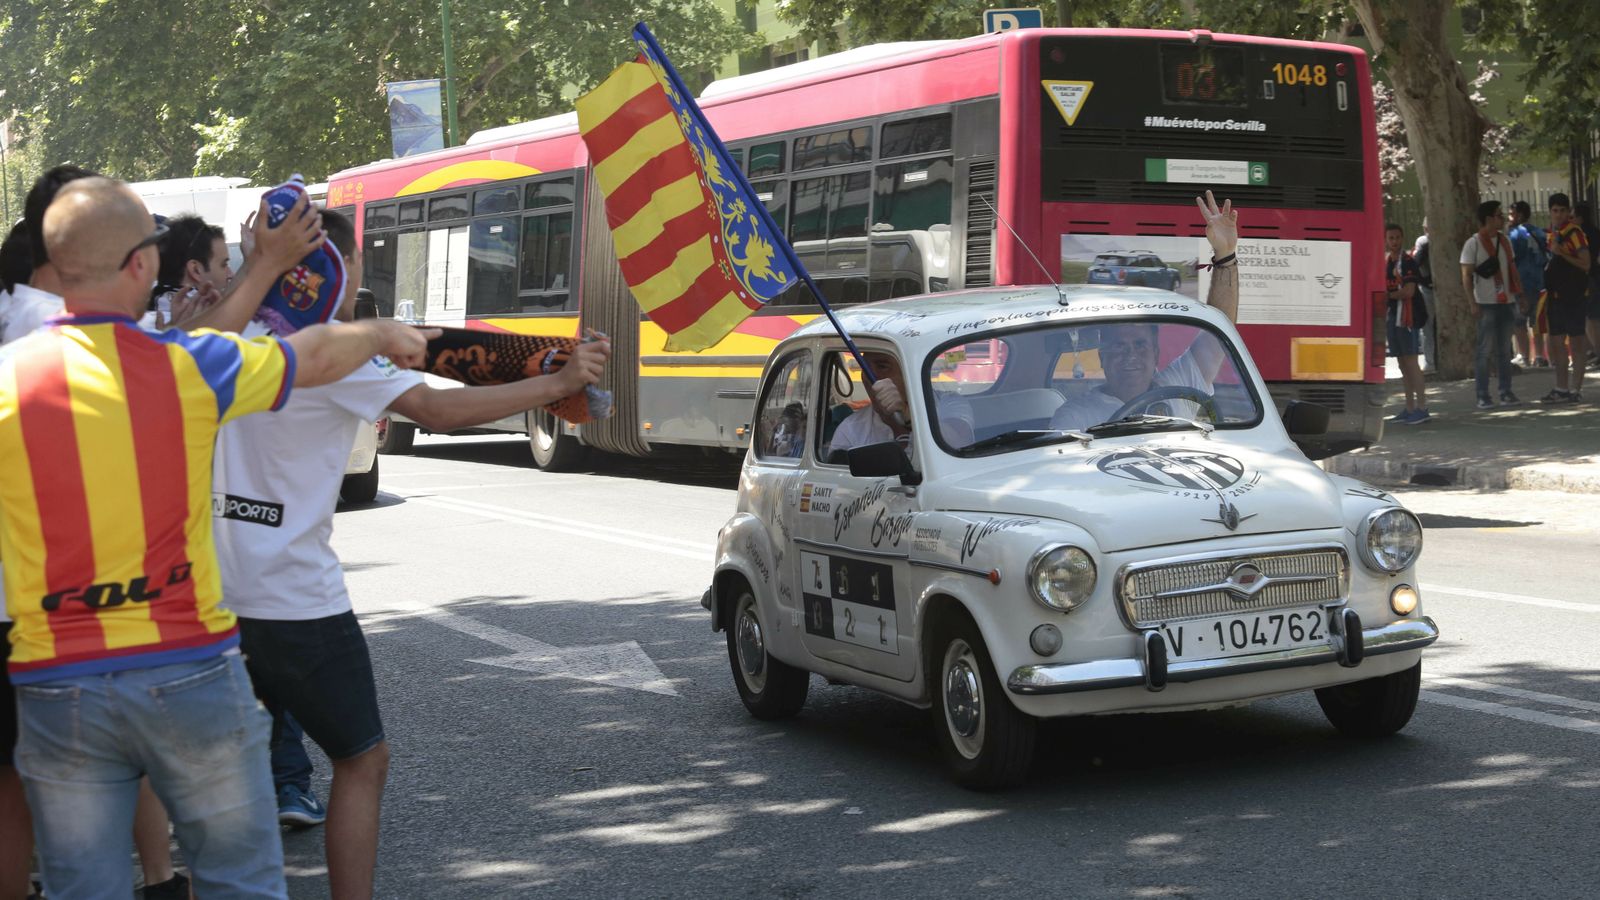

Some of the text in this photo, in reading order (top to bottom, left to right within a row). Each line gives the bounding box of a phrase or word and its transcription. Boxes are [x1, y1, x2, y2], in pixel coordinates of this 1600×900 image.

[993, 14, 1019, 33] P
[1272, 63, 1328, 86] 1048
[1144, 116, 1267, 132] #MuéveteporSevilla
[1237, 243, 1311, 257] ESTÁ LA SEÑAL
[813, 486, 833, 498] SANTY
[1173, 490, 1210, 500] 1919
[811, 501, 831, 513] NACHO
[1166, 611, 1324, 657] V 104762
